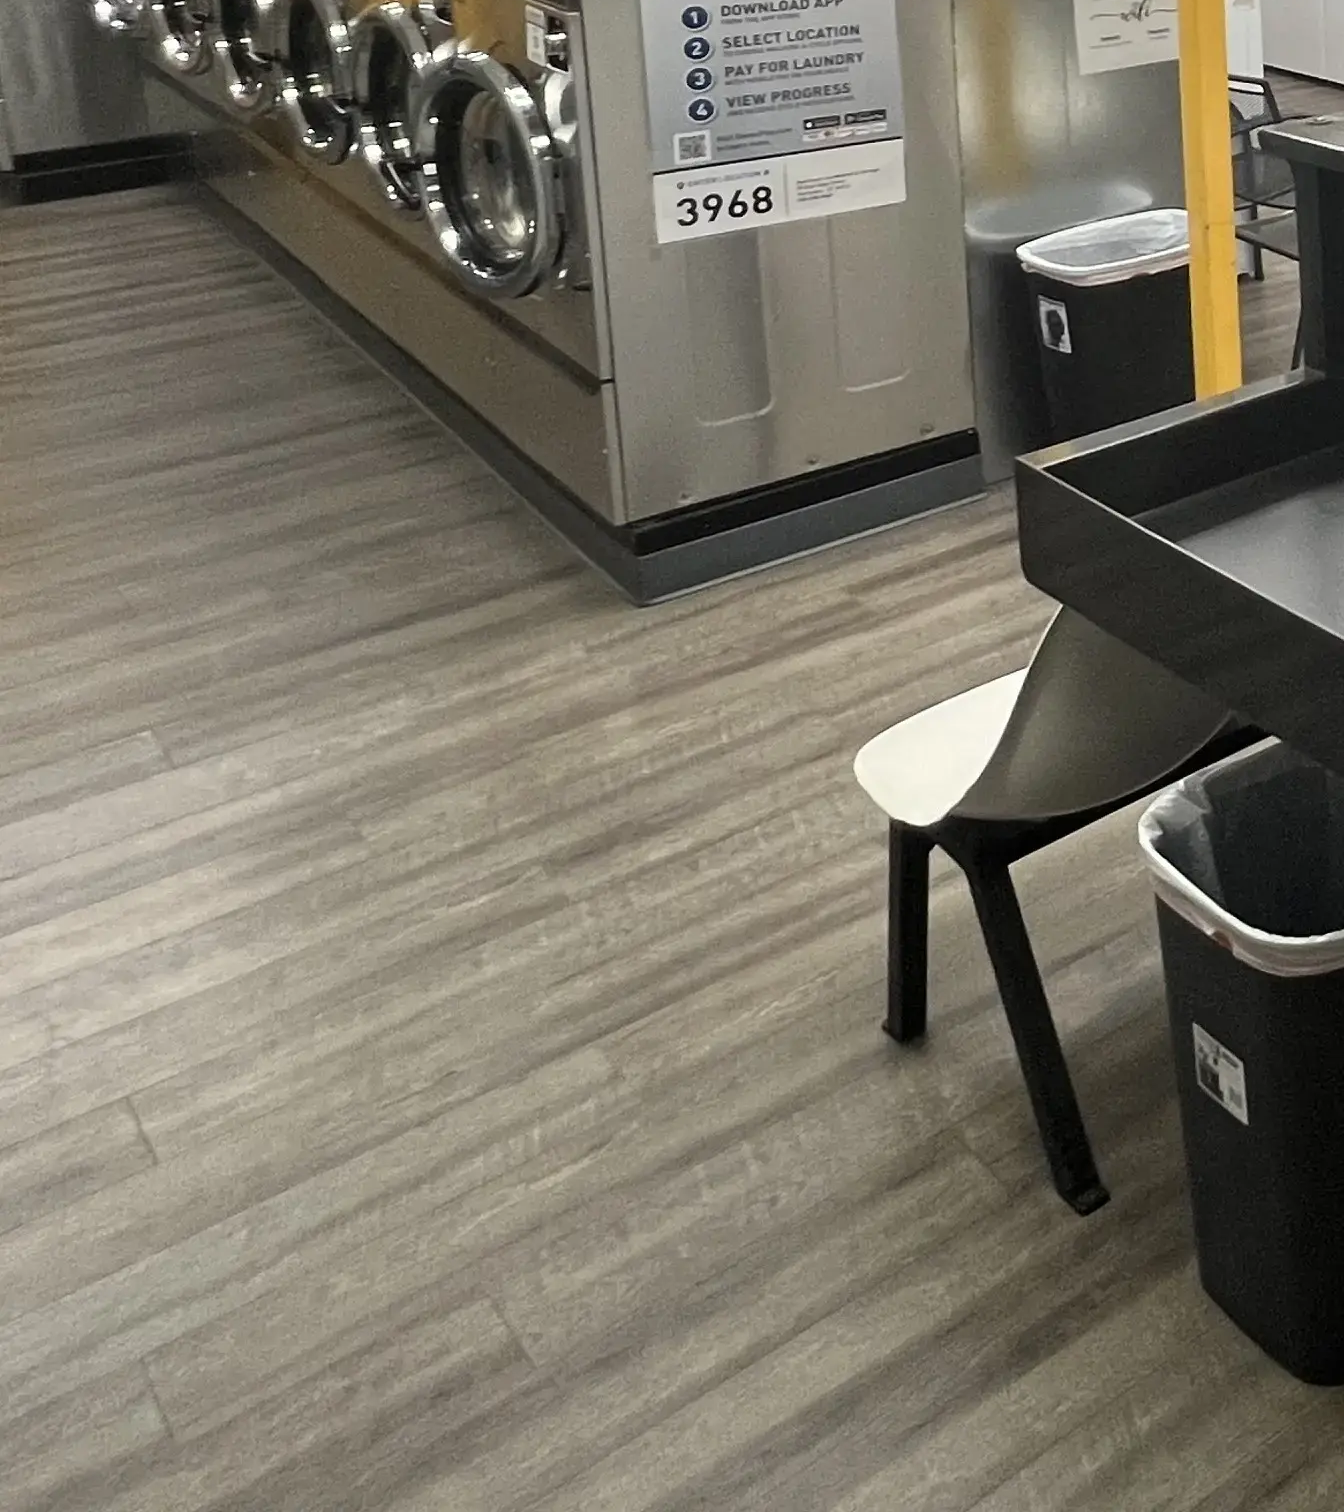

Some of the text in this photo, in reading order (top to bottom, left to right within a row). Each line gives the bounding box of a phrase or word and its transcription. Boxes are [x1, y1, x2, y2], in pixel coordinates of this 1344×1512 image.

[690, 11, 699, 24] 1
[691, 42, 702, 55] 2
[722, 31, 781, 49] SELECT
[786, 25, 860, 43] LOCATION
[694, 72, 705, 85] 3
[725, 65, 754, 78] PAY
[758, 60, 789, 73] FOR
[793, 51, 865, 70] LAUNDRY
[696, 103, 708, 116] 4
[726, 94, 767, 108] VIEW
[771, 83, 851, 102] PROGRESS
[676, 186, 773, 226] 3968
